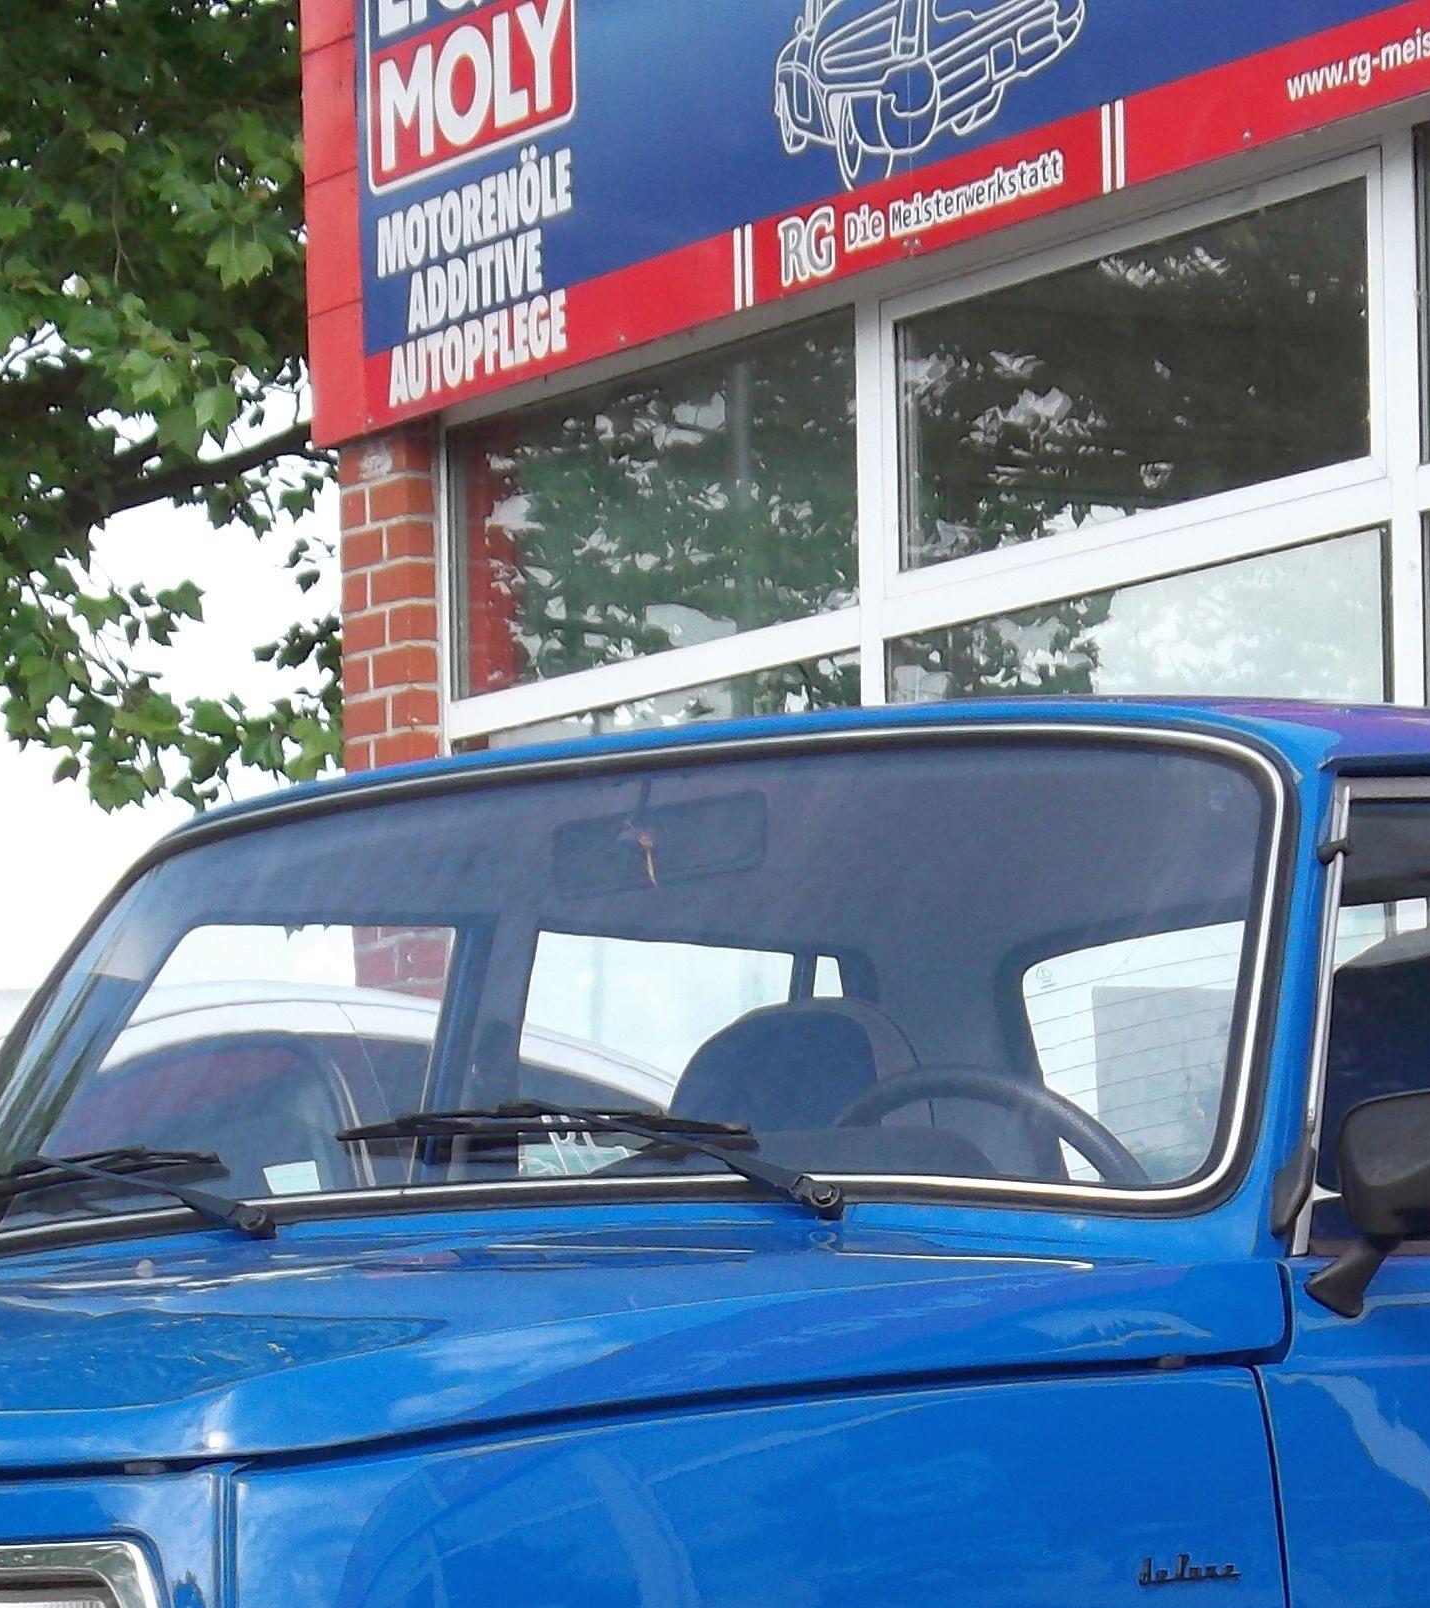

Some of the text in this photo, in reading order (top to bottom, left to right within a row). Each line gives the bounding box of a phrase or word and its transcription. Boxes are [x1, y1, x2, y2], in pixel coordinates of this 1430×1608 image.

[379, 0, 565, 172] MOLY
[378, 144, 572, 278] MOTORENÖLE
[777, 148, 1065, 287] RG Die Meisterwerkstatt
[389, 288, 567, 408] AUTOPFLEGE
[409, 228, 542, 334] ADDITIVE
